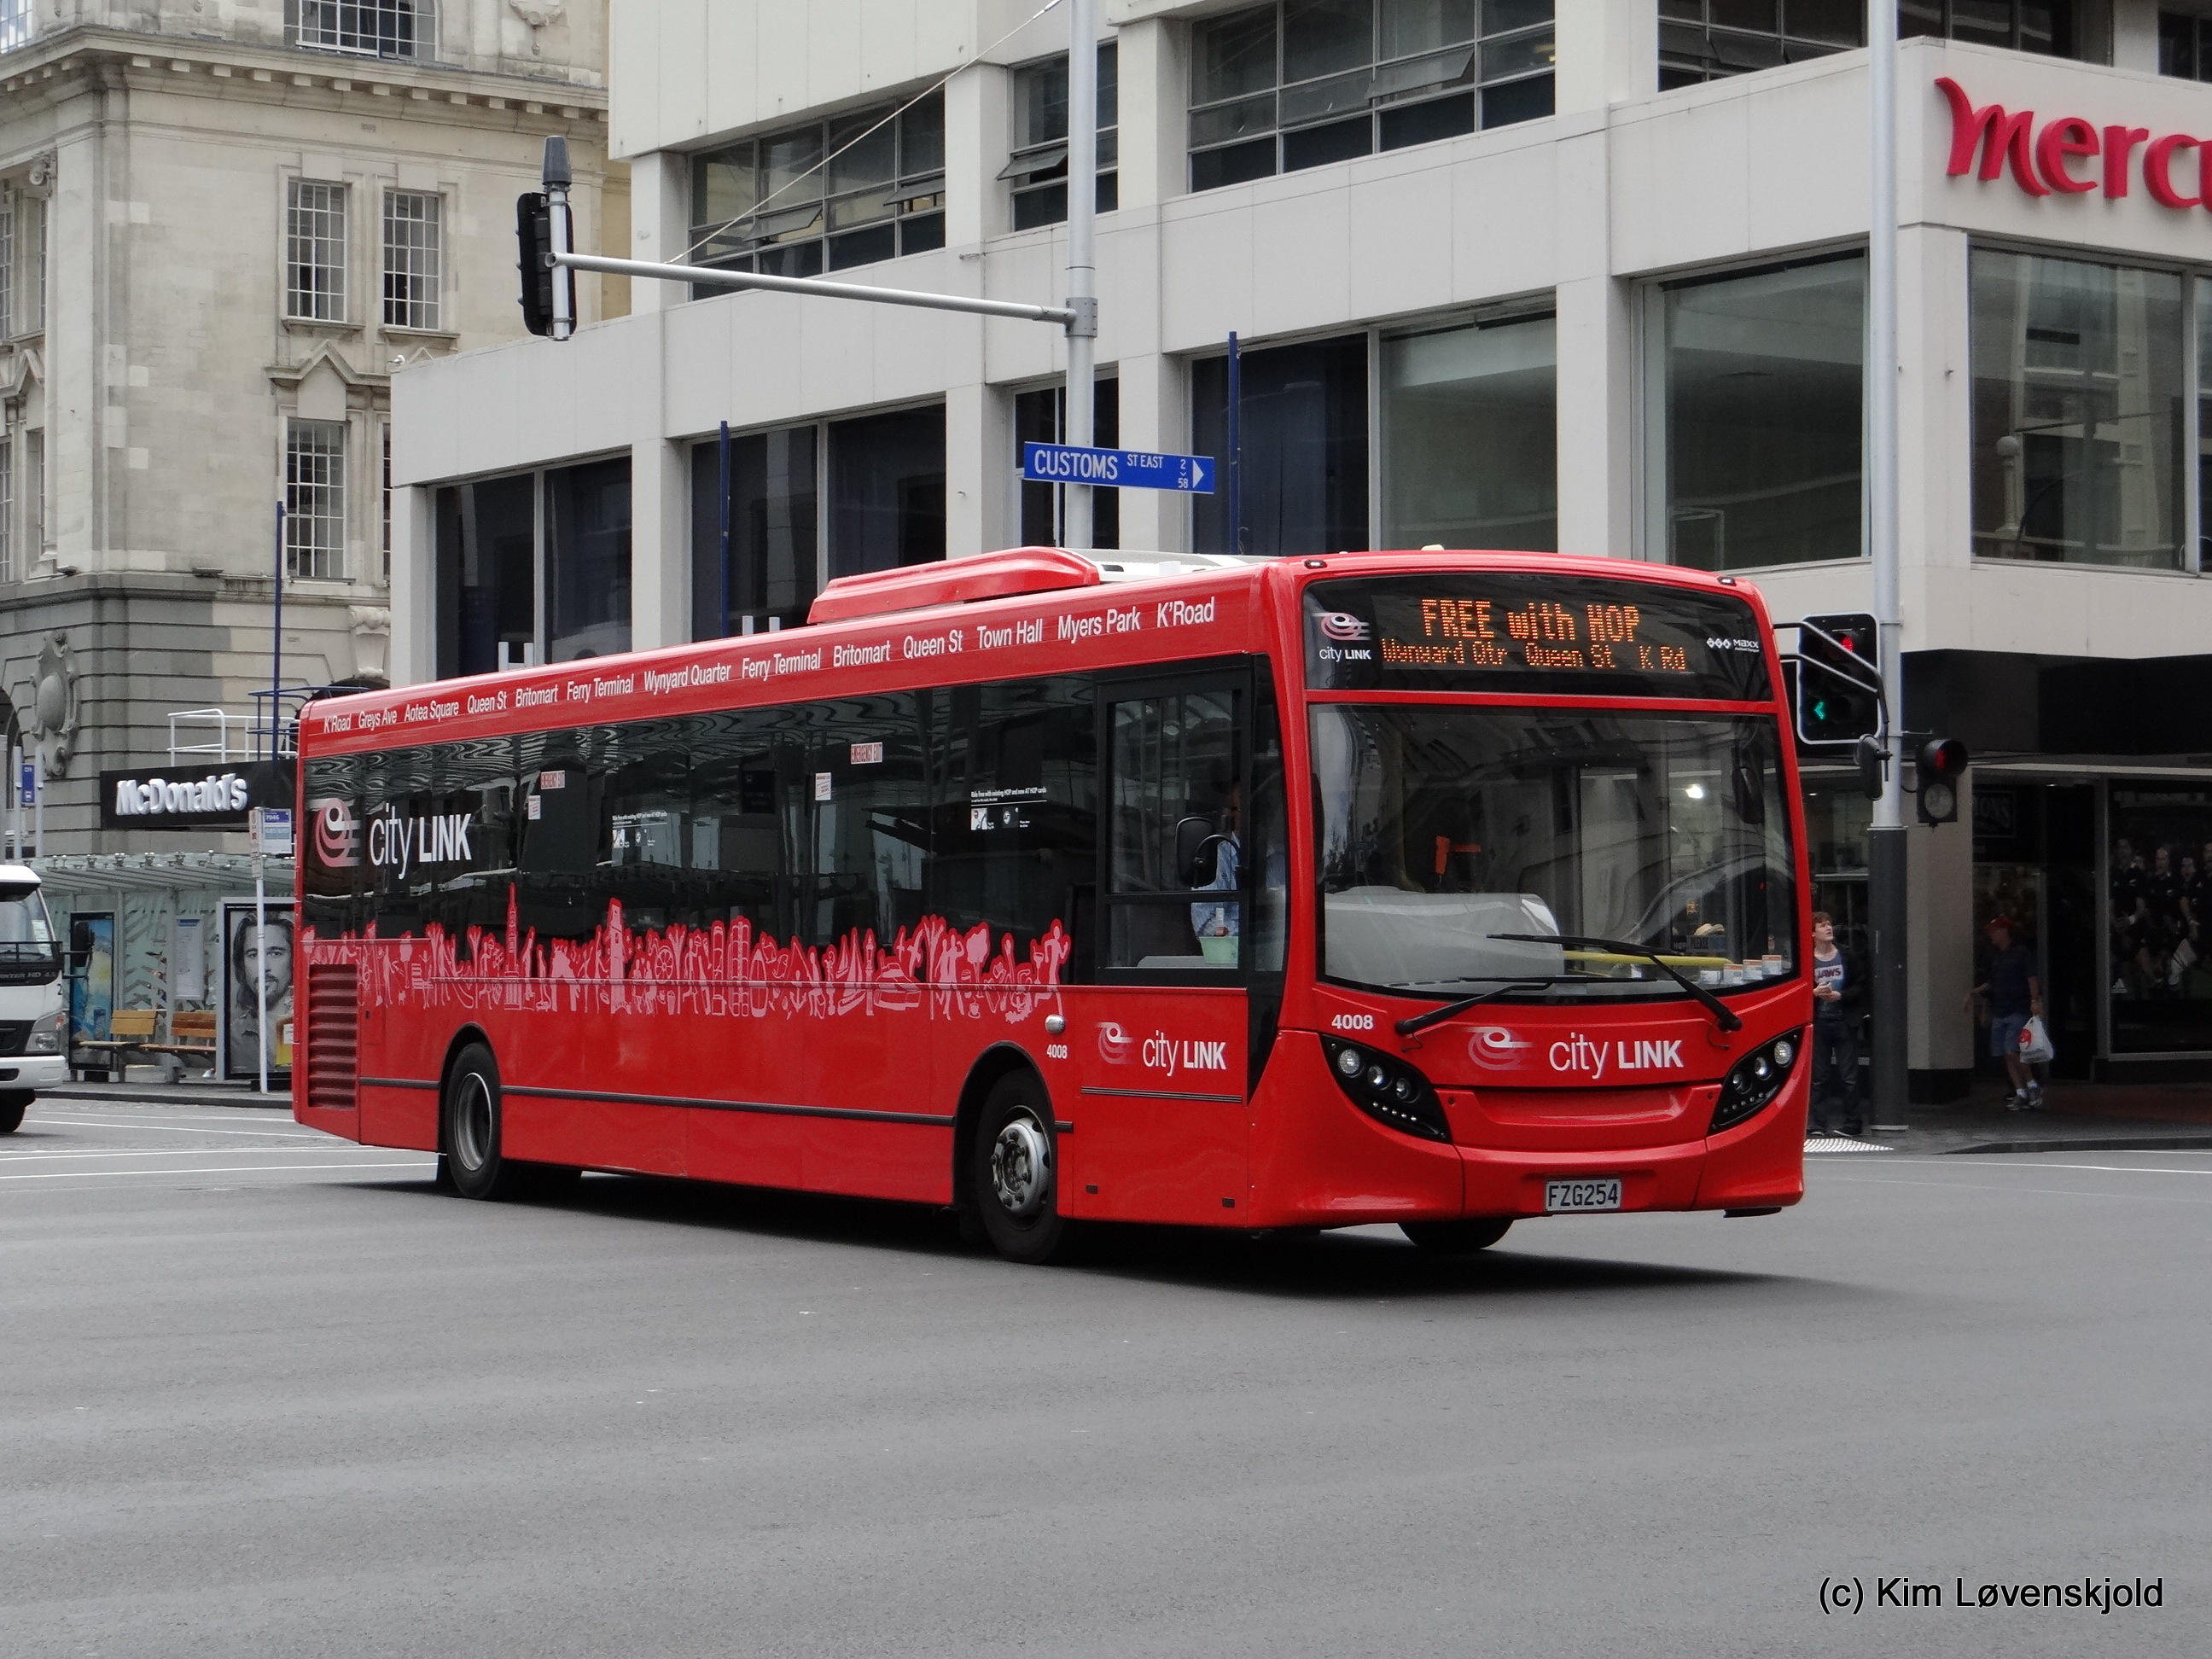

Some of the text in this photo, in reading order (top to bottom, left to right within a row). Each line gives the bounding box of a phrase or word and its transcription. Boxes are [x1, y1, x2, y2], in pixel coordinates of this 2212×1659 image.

[1034, 449, 1164, 480] CUSTOMS ST EAST
[1180, 459, 1185, 469] 2
[1178, 478, 1189, 489] 58
[1422, 599, 1639, 642] FREE with HOP
[323, 596, 1215, 733] K'Road Greys Ave Aotea Square Queen St Britomart Ferry Terminal Wynyard Quarter Ferry Terminal Britomart Queen St Town Hall Myers Park K'Road
[1319, 646, 1371, 662] city LINK
[1382, 638, 1686, 670] Wynyard Qtr Queen St K Rd
[116, 773, 248, 816] McDonald's
[370, 802, 472, 879] city LINK
[1331, 1013, 1374, 1031] 4008
[1046, 1044, 1068, 1059] 4008
[1143, 1029, 1227, 1077] city LINK
[1548, 1032, 1685, 1080] city LINK
[1547, 1181, 1619, 1208] FZG254
